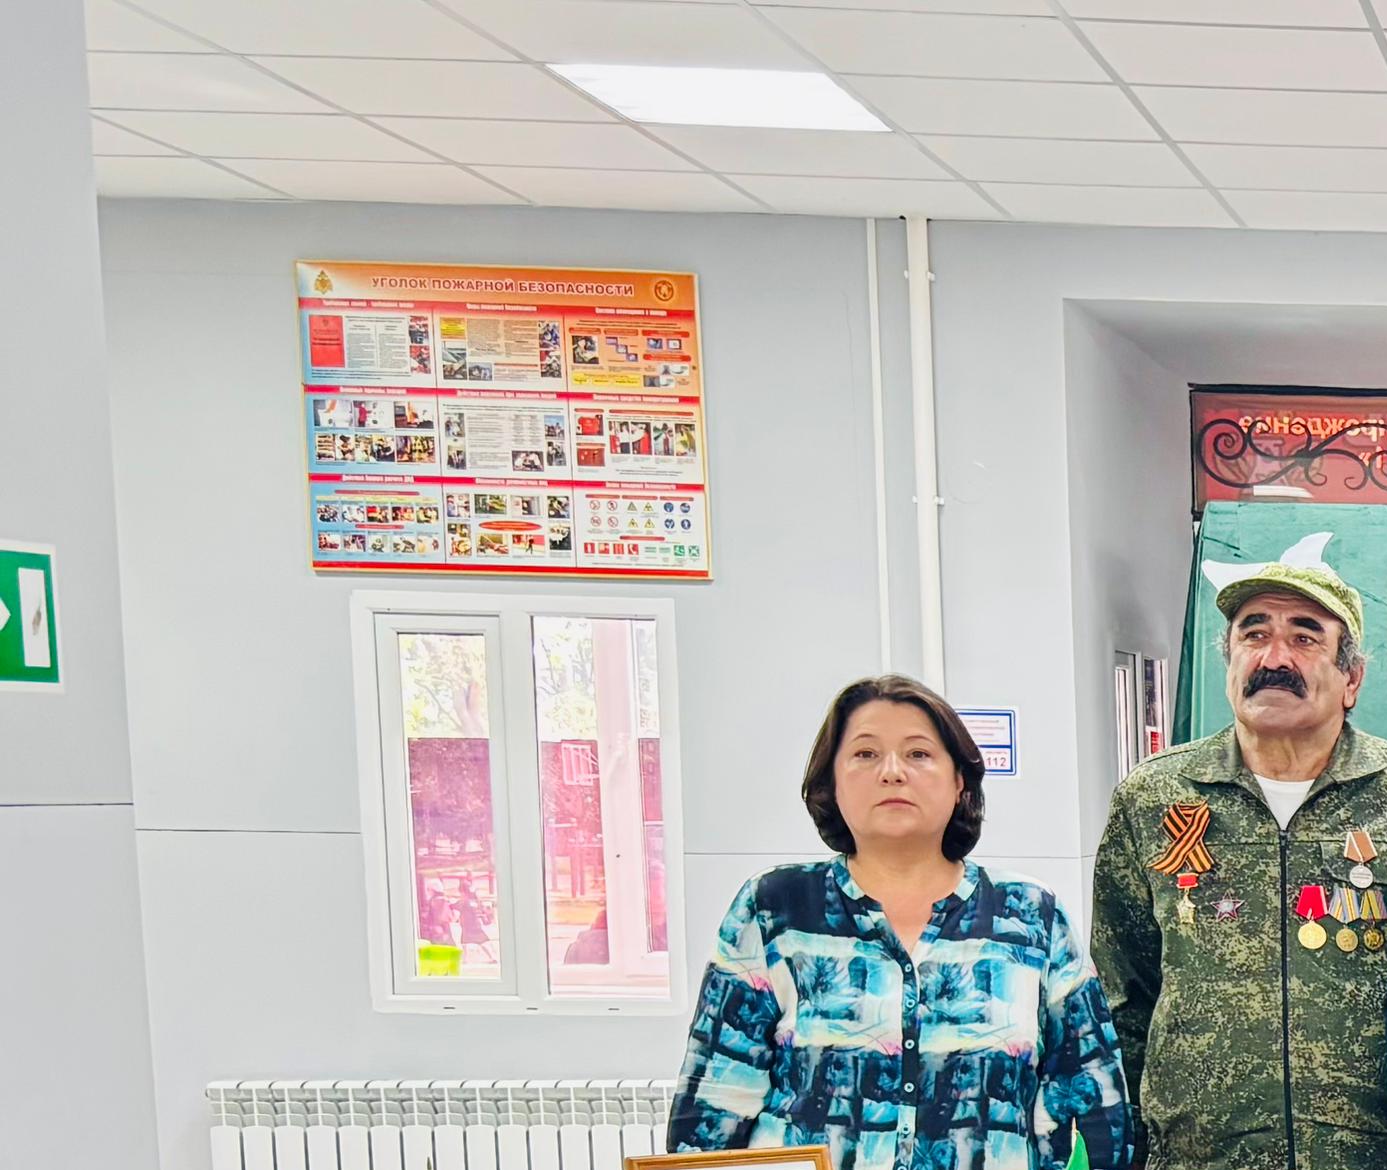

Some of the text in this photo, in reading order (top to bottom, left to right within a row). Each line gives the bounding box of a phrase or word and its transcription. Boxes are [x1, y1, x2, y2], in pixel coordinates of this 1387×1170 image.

[372, 276, 635, 297] УГОЛОК ПОЖАРНОЙ БЕЗОПАСНОСТИ
